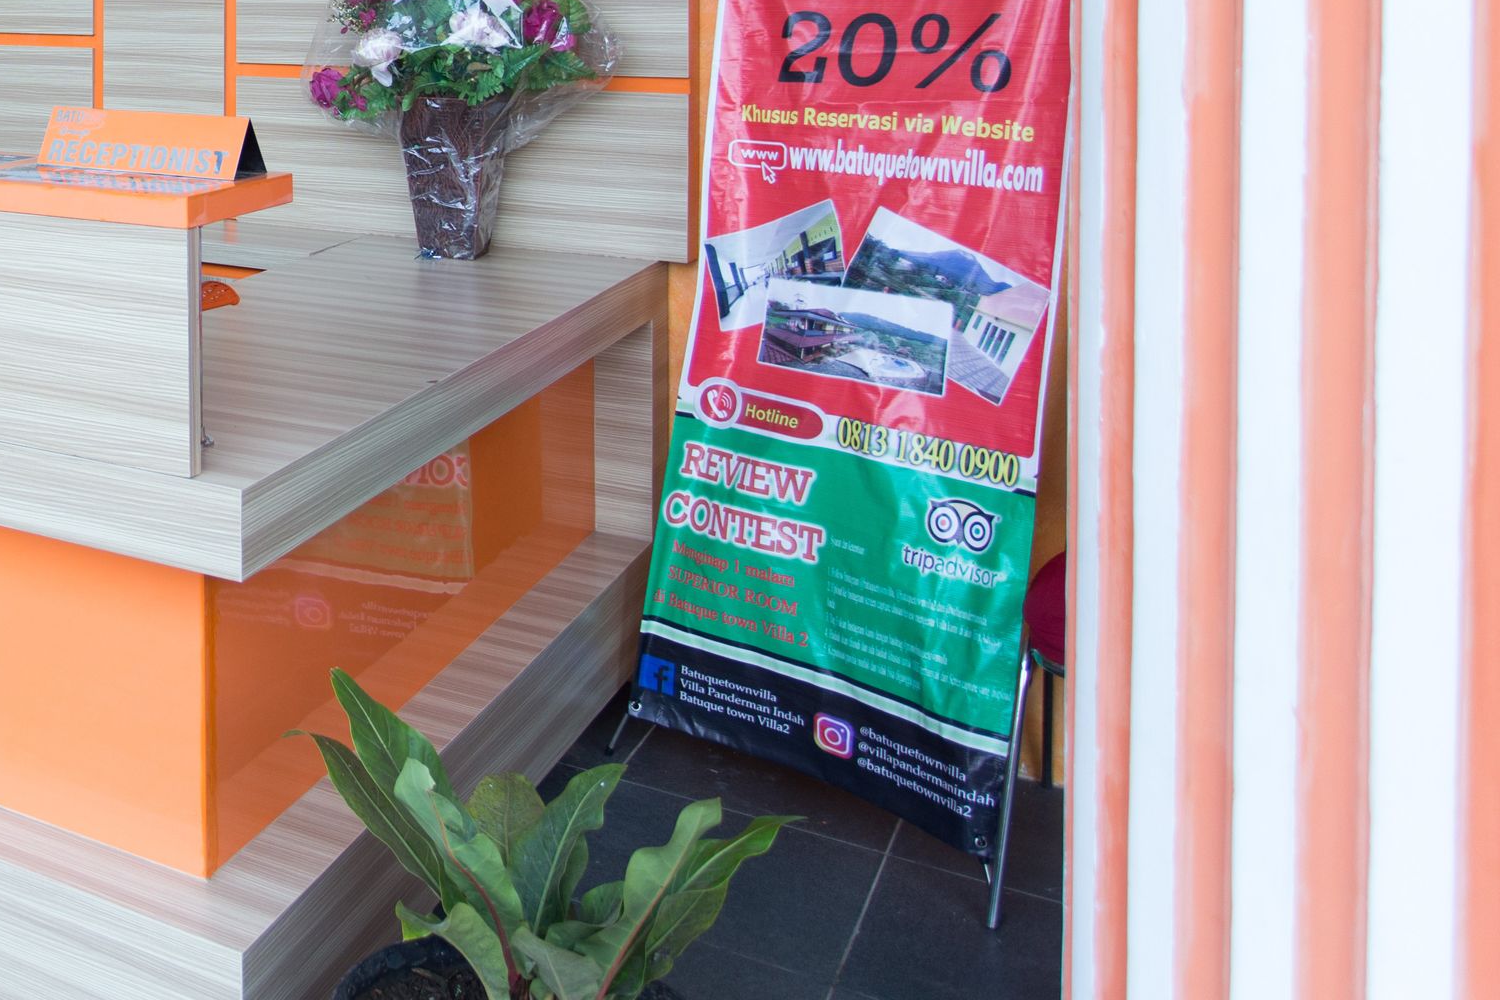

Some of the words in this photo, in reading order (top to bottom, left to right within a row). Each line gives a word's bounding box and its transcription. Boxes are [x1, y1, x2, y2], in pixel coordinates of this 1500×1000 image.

[777, 10, 1013, 93] 20%
[741, 103, 798, 125] Khusus
[803, 106, 898, 132] Reservasi
[904, 112, 934, 134] via
[941, 115, 1035, 142] Website
[47, 139, 229, 176] RECEPTIONIST
[789, 139, 1044, 192] www.batuquetownvilla.com
[744, 403, 799, 430] Hotline
[680, 442, 813, 503] REVIEW
[837, 417, 889, 457] 0813
[895, 430, 954, 473] 1840
[959, 444, 1020, 487] 0900
[665, 491, 823, 562] CONTEST
[668, 565, 740, 601] SUPERIOR
[744, 588, 799, 616] ROOM
[903, 544, 998, 588] tripadvisor
[668, 593, 719, 621] Batuque
[722, 610, 757, 632] town
[762, 619, 795, 647] Villa
[800, 631, 809, 648] 2
[680, 665, 777, 702] Batuquetownvilla
[680, 678, 706, 695] Villa
[707, 687, 771, 715] Panderman
[773, 706, 805, 727] Indah
[679, 691, 724, 713] Batuque
[726, 705, 755, 723] town
[757, 715, 791, 735] Villa2
[858, 742, 996, 808] @villapandermanindah
[859, 726, 967, 783] @batuquetownvilla
[857, 756, 973, 818] @batuquetownvilla2
